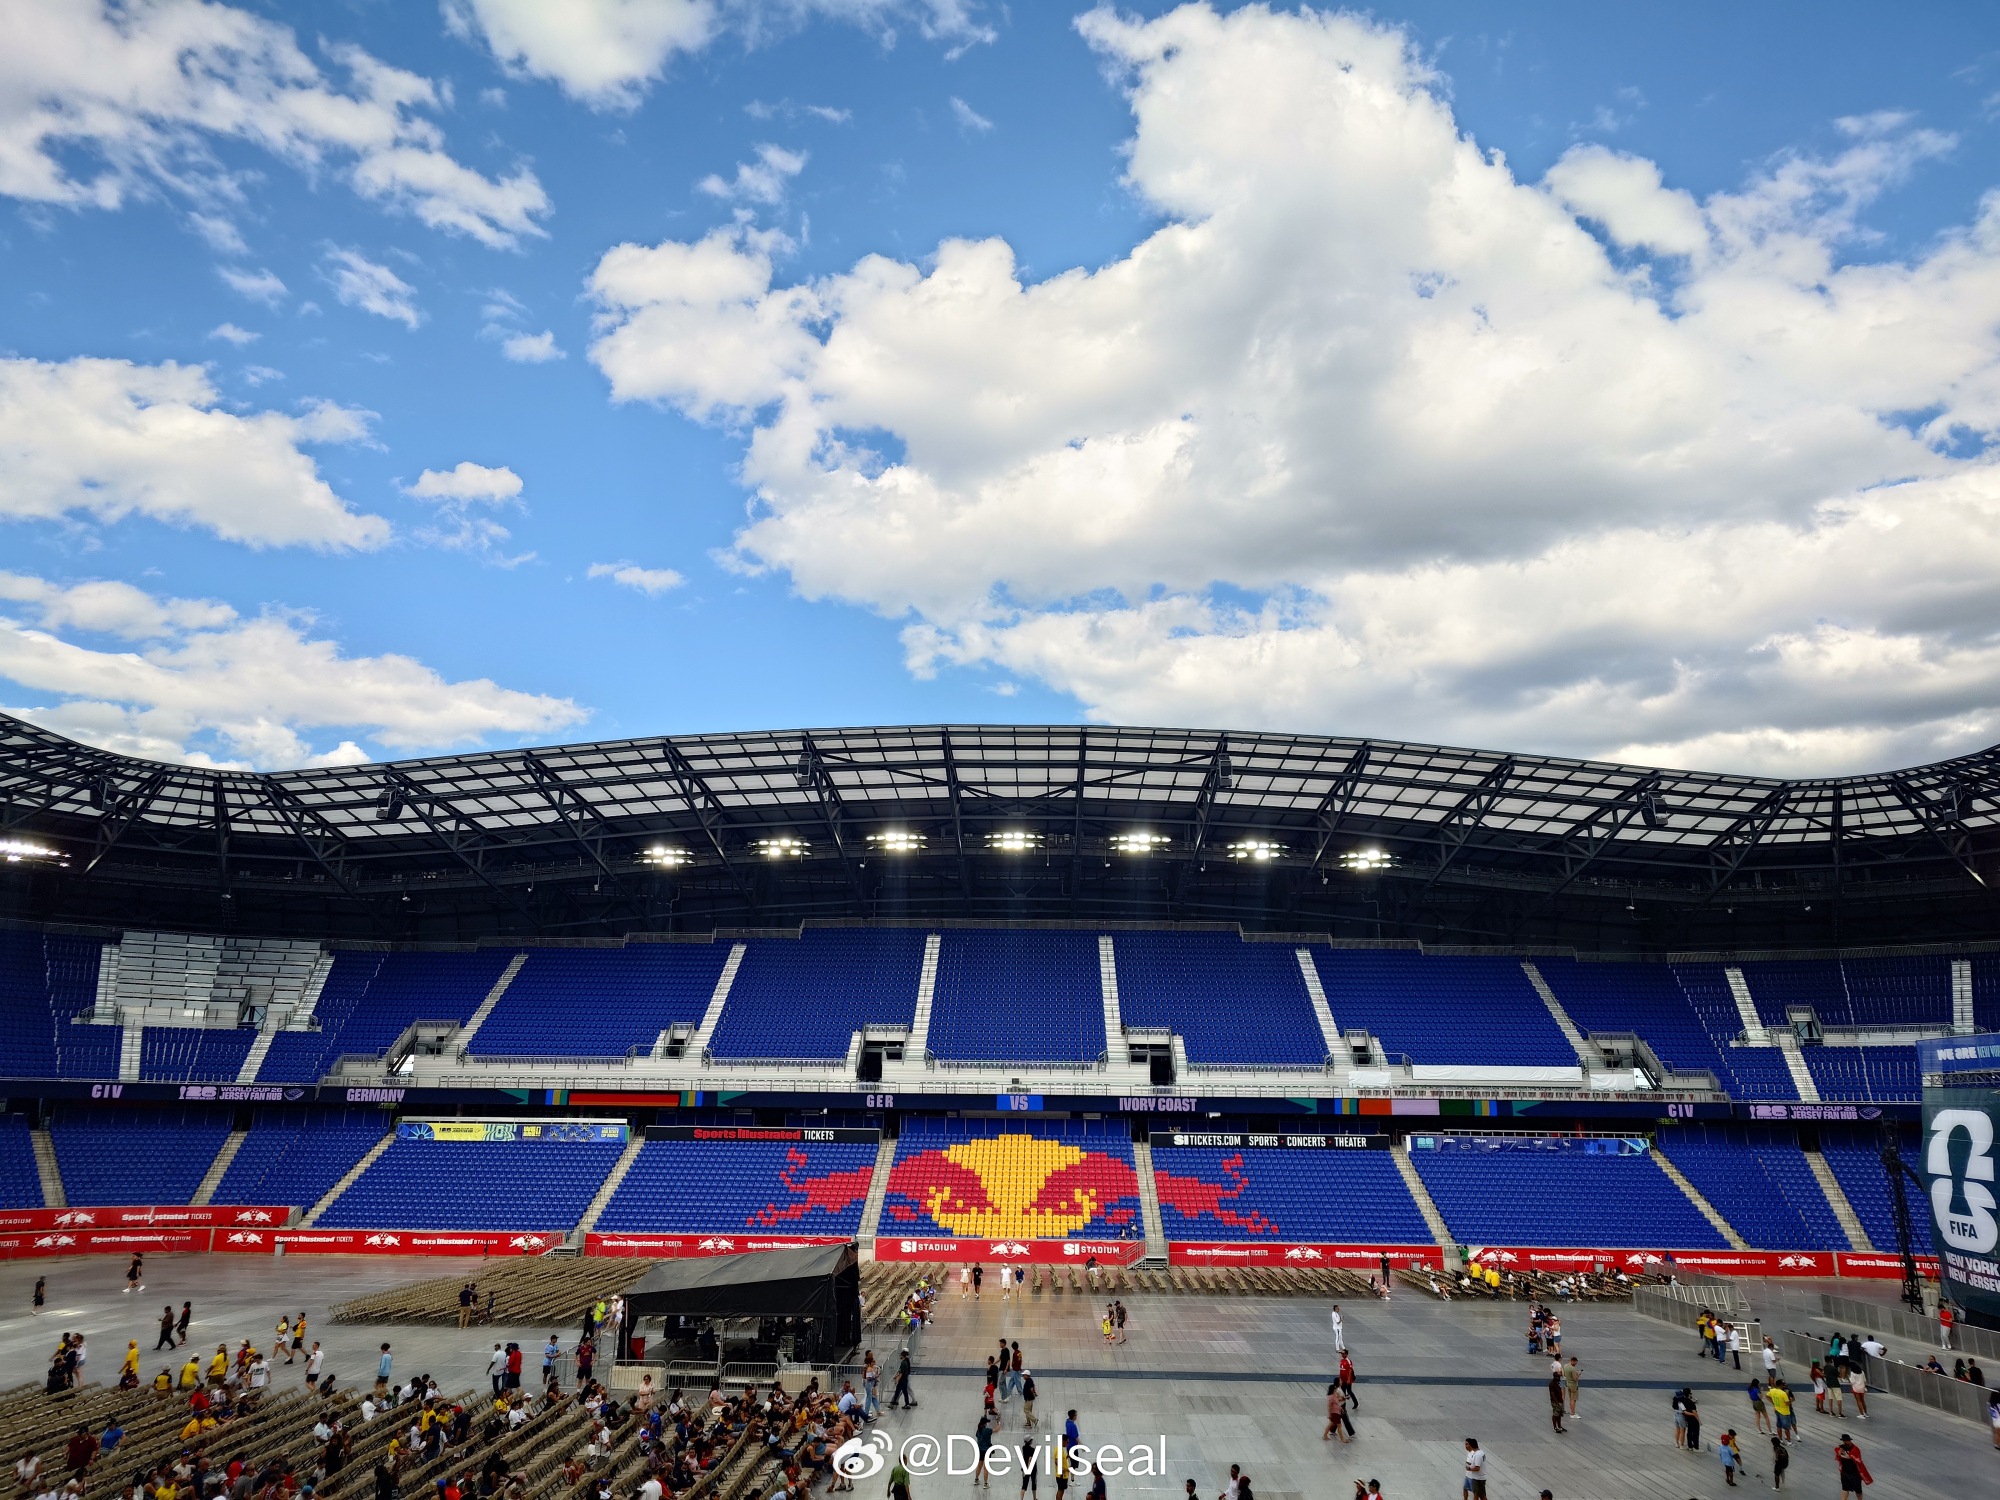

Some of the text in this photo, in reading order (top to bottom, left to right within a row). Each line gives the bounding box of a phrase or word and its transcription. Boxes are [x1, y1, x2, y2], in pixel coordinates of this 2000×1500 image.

[1937, 1049, 1954, 1060] WE
[91, 1084, 123, 1098] CIV
[220, 1092, 282, 1100] JERSEY FAN HUB
[346, 1088, 406, 1102] GERMANY
[866, 1094, 894, 1108] GER
[1010, 1096, 1029, 1111] VS
[1120, 1098, 1197, 1111] IVORY COAST
[1668, 1104, 1694, 1117] CIV
[1791, 1111, 1821, 1119] JERSEY
[1823, 1111, 1840, 1119] FAN
[1841, 1111, 1857, 1119] HUB
[694, 1129, 834, 1140] Sports Illustrated TICKETS
[1249, 1136, 1278, 1146] SPORTS
[1287, 1137, 1326, 1147] CONCERTS
[1334, 1137, 1366, 1147] THEATER
[1949, 1220, 1978, 1239] FIFA
[901, 1241, 916, 1253] SI
[1063, 1243, 1120, 1255] SI STADIUM
[1922, 1262, 1941, 1270] TICET
[1945, 1250, 2000, 1276] NEW YORK
[1948, 1266, 1966, 1284] NEW
